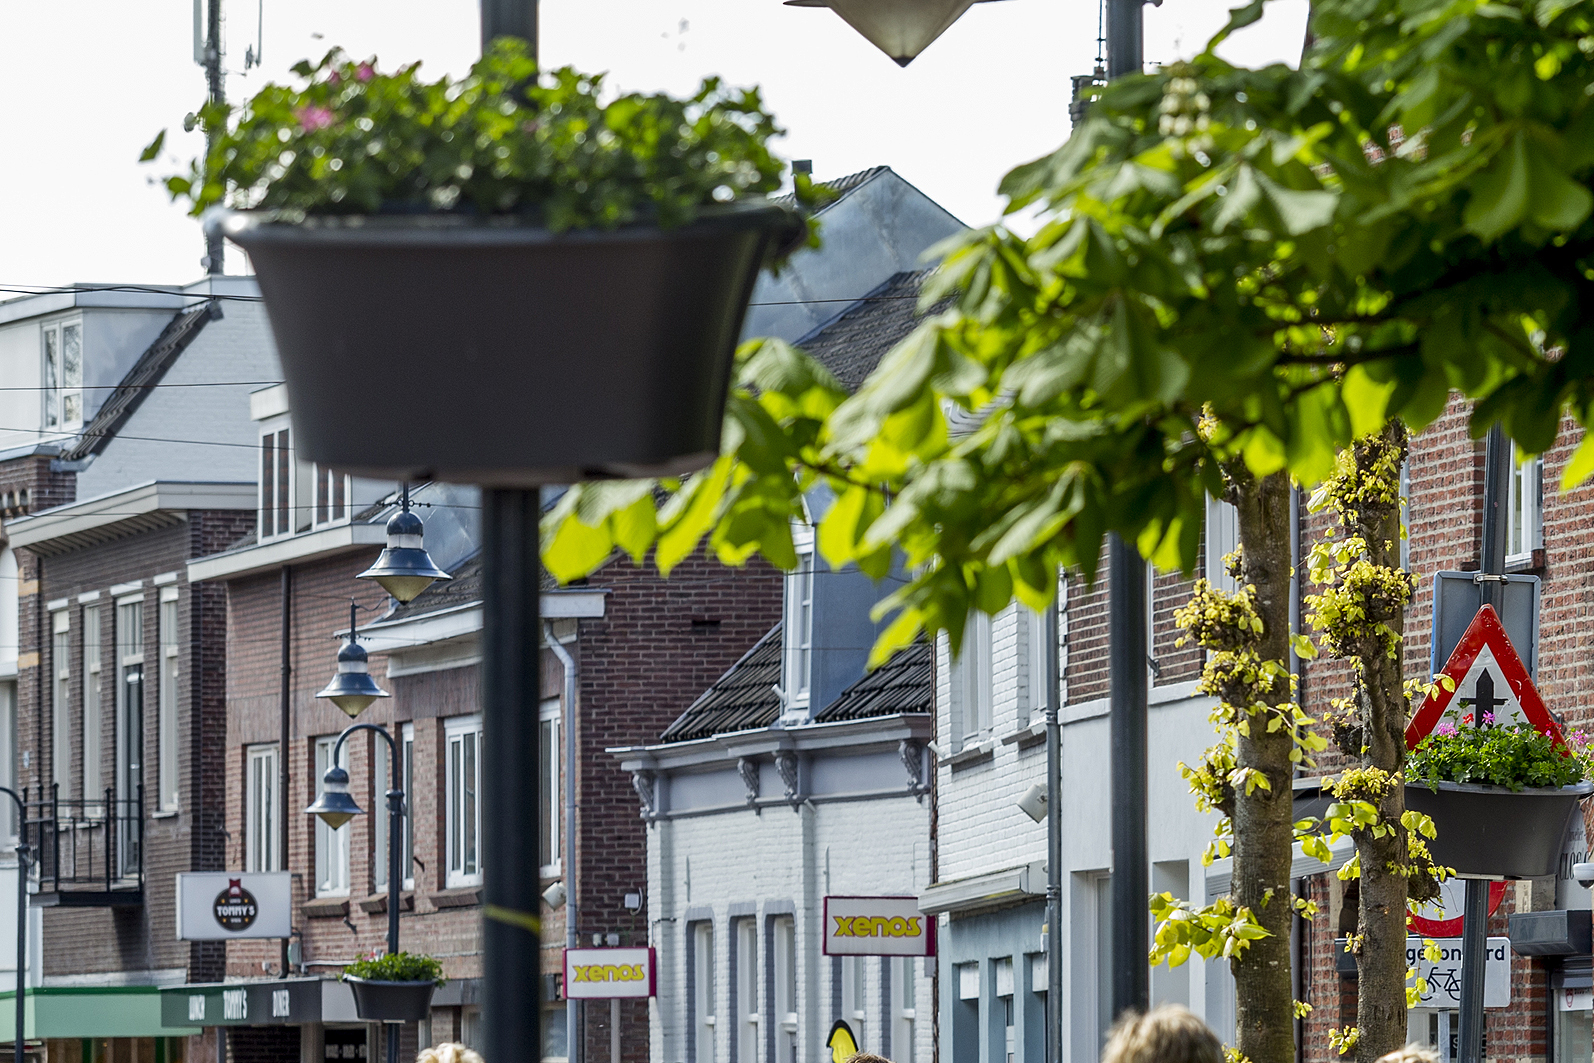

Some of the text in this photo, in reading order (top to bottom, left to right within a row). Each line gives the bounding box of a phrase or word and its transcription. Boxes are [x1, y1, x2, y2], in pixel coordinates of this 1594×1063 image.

[216, 905, 255, 917] TOMMY'S
[832, 915, 922, 938] xenos
[1406, 945, 1505, 966] geonrd
[573, 963, 645, 983] xenos
